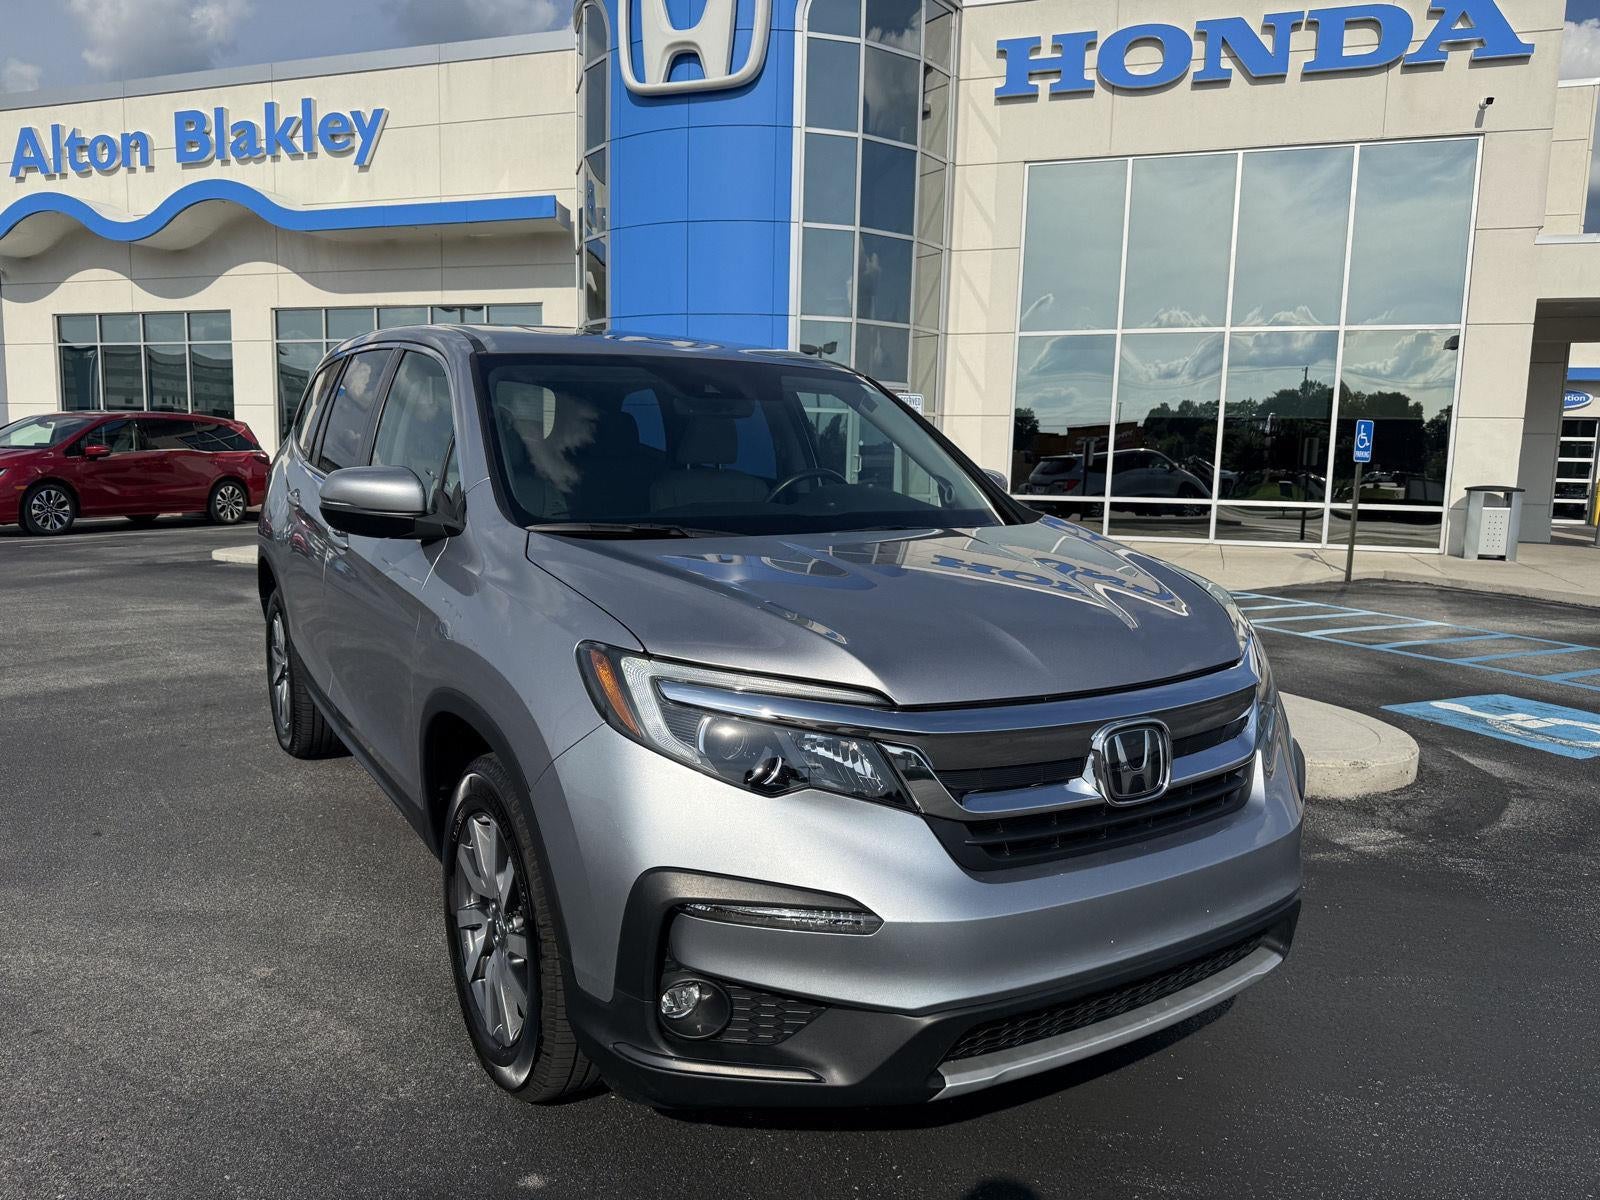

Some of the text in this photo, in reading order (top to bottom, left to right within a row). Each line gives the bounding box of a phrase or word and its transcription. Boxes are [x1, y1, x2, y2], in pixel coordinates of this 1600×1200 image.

[994, 0, 1536, 98] HONDA
[9, 97, 389, 180] Alton Blakley
[1564, 394, 1586, 402] tion
[1354, 450, 1371, 458] PARKING
